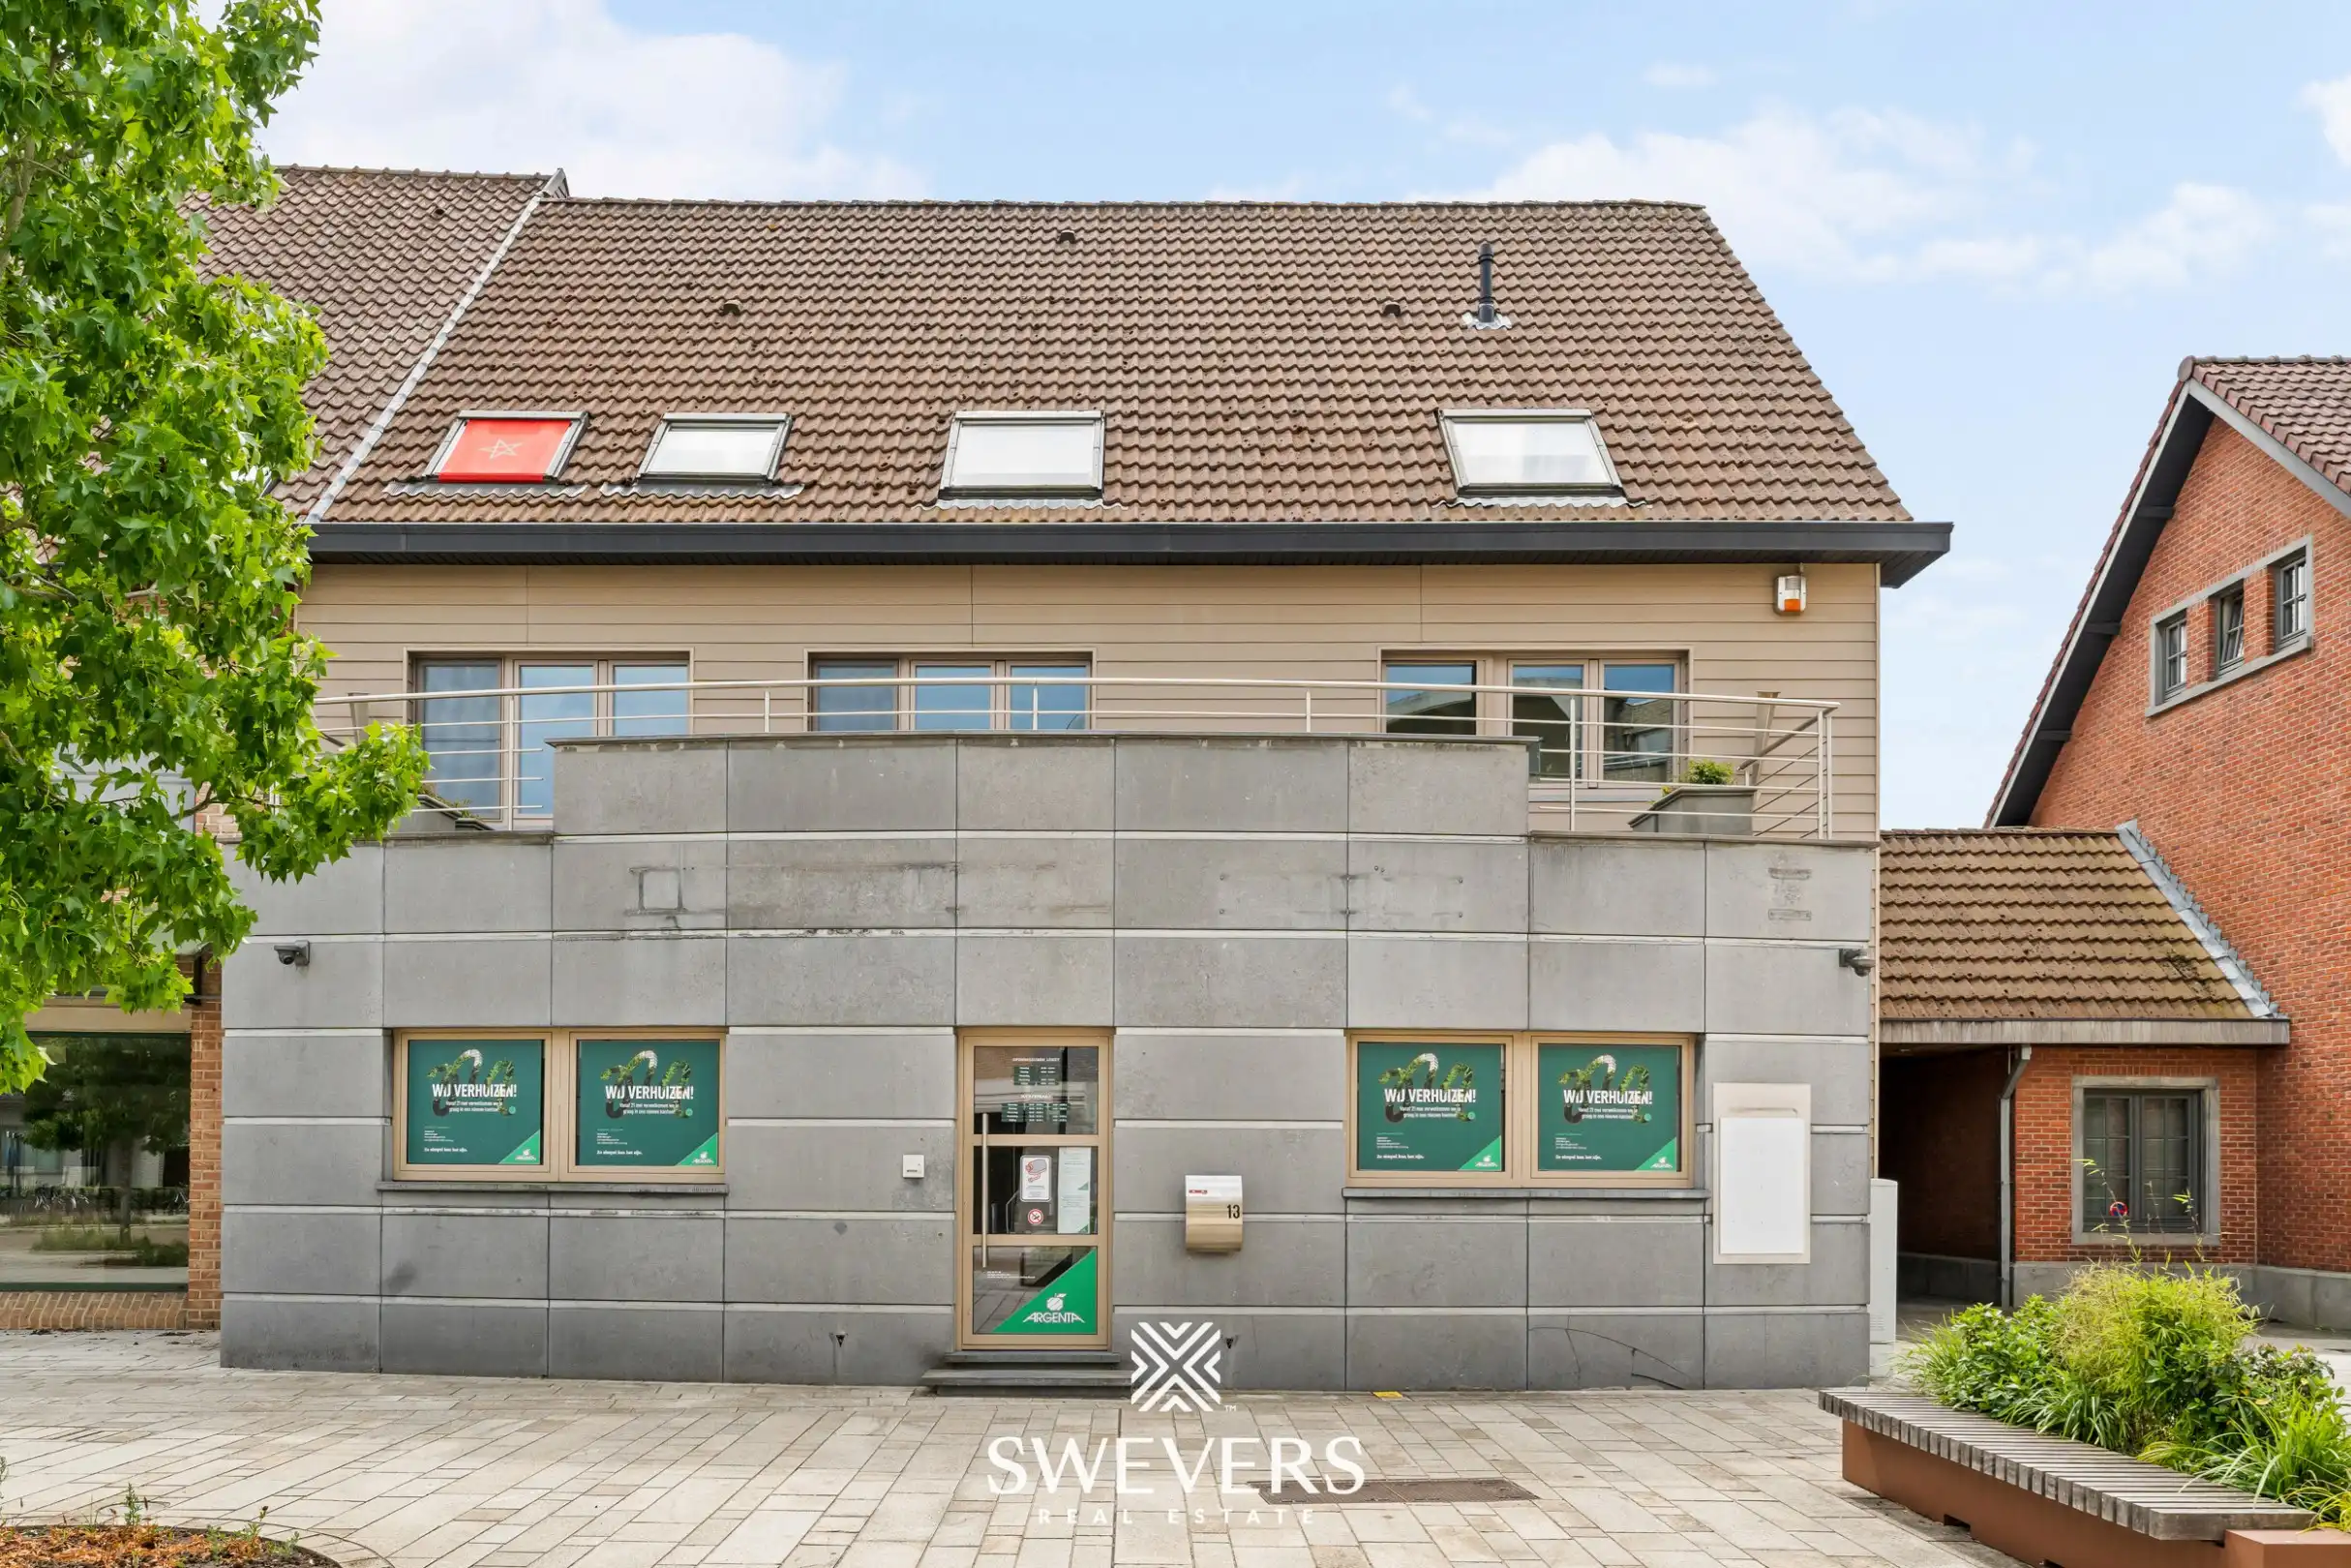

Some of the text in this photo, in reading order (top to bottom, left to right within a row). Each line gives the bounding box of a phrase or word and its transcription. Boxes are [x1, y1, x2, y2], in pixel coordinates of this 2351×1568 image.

[432, 1083, 517, 1098] WIJ VERHUIZEN!
[605, 1085, 694, 1100] WIJ VERHUIZEN!
[1384, 1088, 1476, 1102] WIJ VERHUIZEN!
[1563, 1089, 1653, 1104] WIJ VERHUIZEN!
[1226, 1204, 1241, 1220] 13
[1022, 1312, 1086, 1324] ARGENTA
